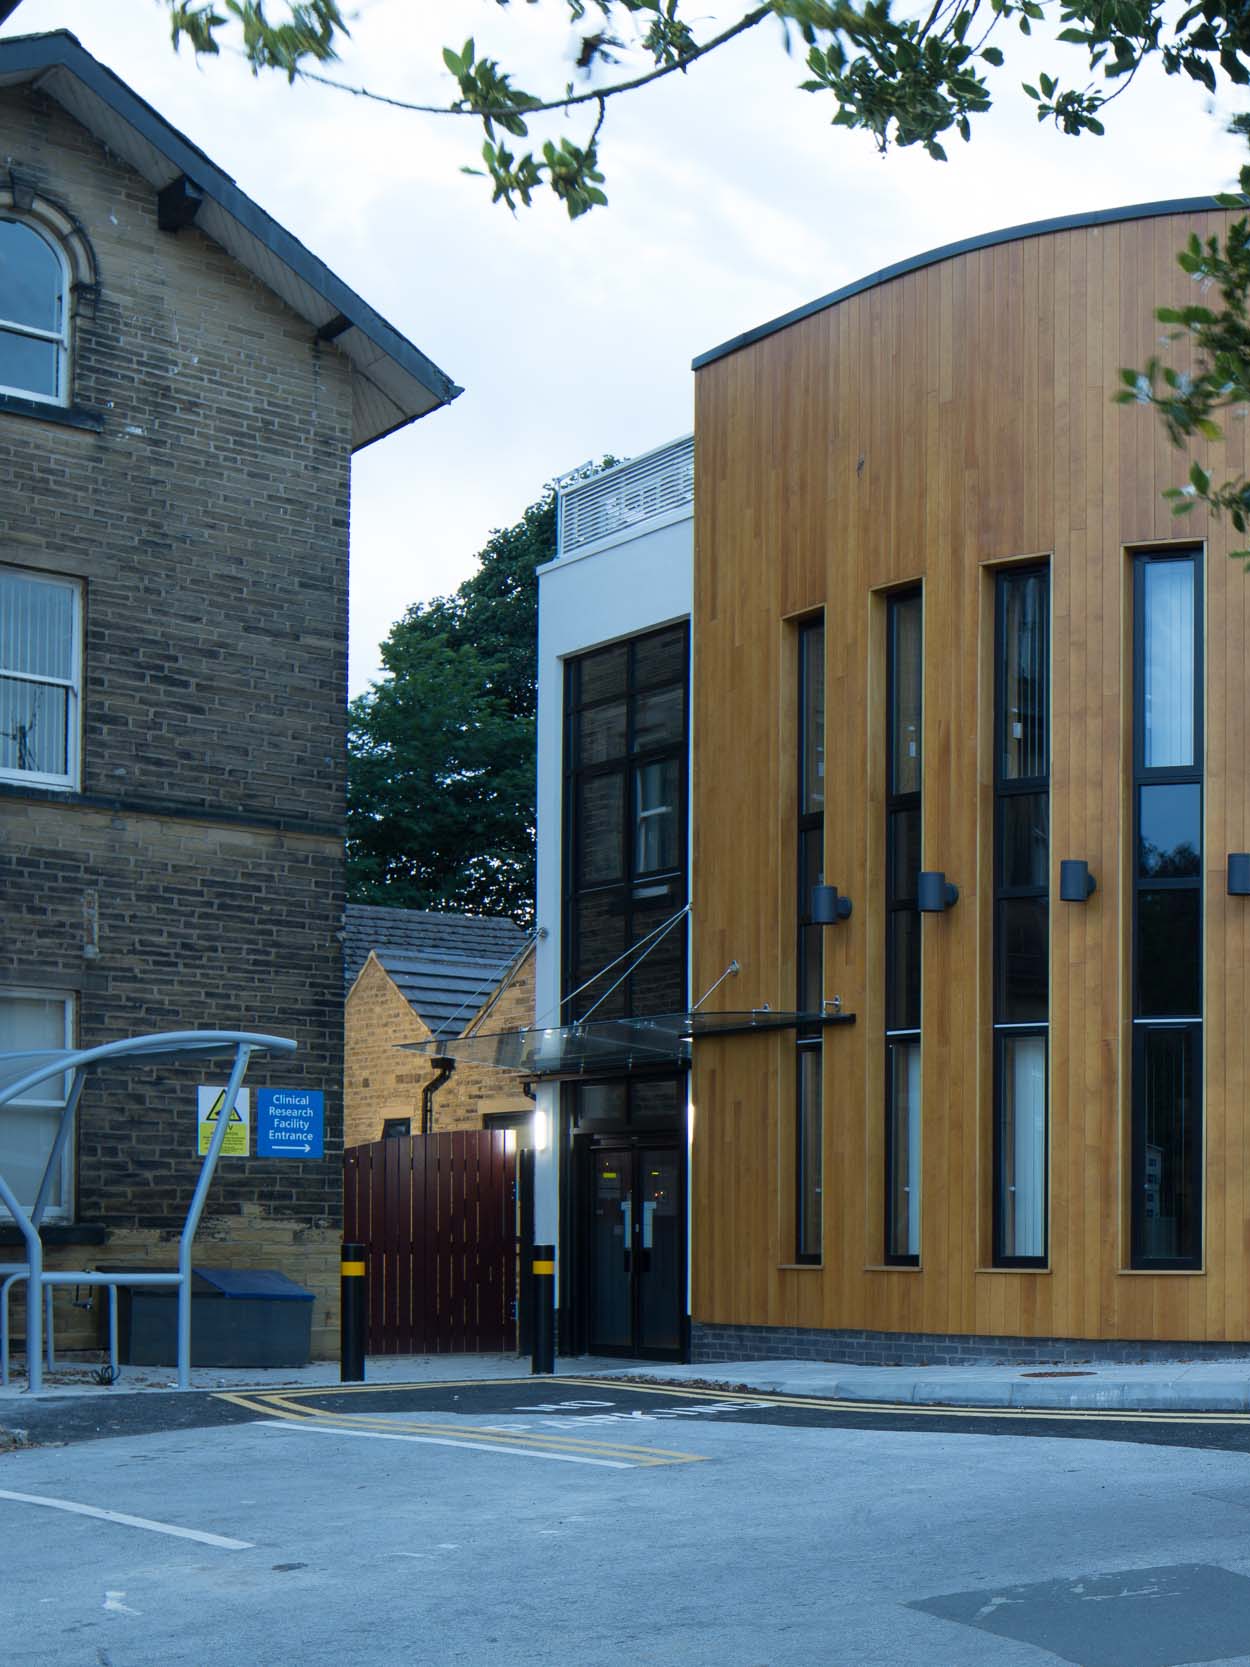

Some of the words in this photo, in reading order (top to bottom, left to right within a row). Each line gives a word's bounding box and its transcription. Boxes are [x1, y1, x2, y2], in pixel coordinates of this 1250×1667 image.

[273, 1094, 309, 1105] Clinical
[269, 1106, 314, 1117] Research
[274, 1118, 310, 1131] Facility
[269, 1129, 314, 1141] Entrance
[513, 1400, 616, 1412] NO
[479, 1401, 777, 1433] PARKING
